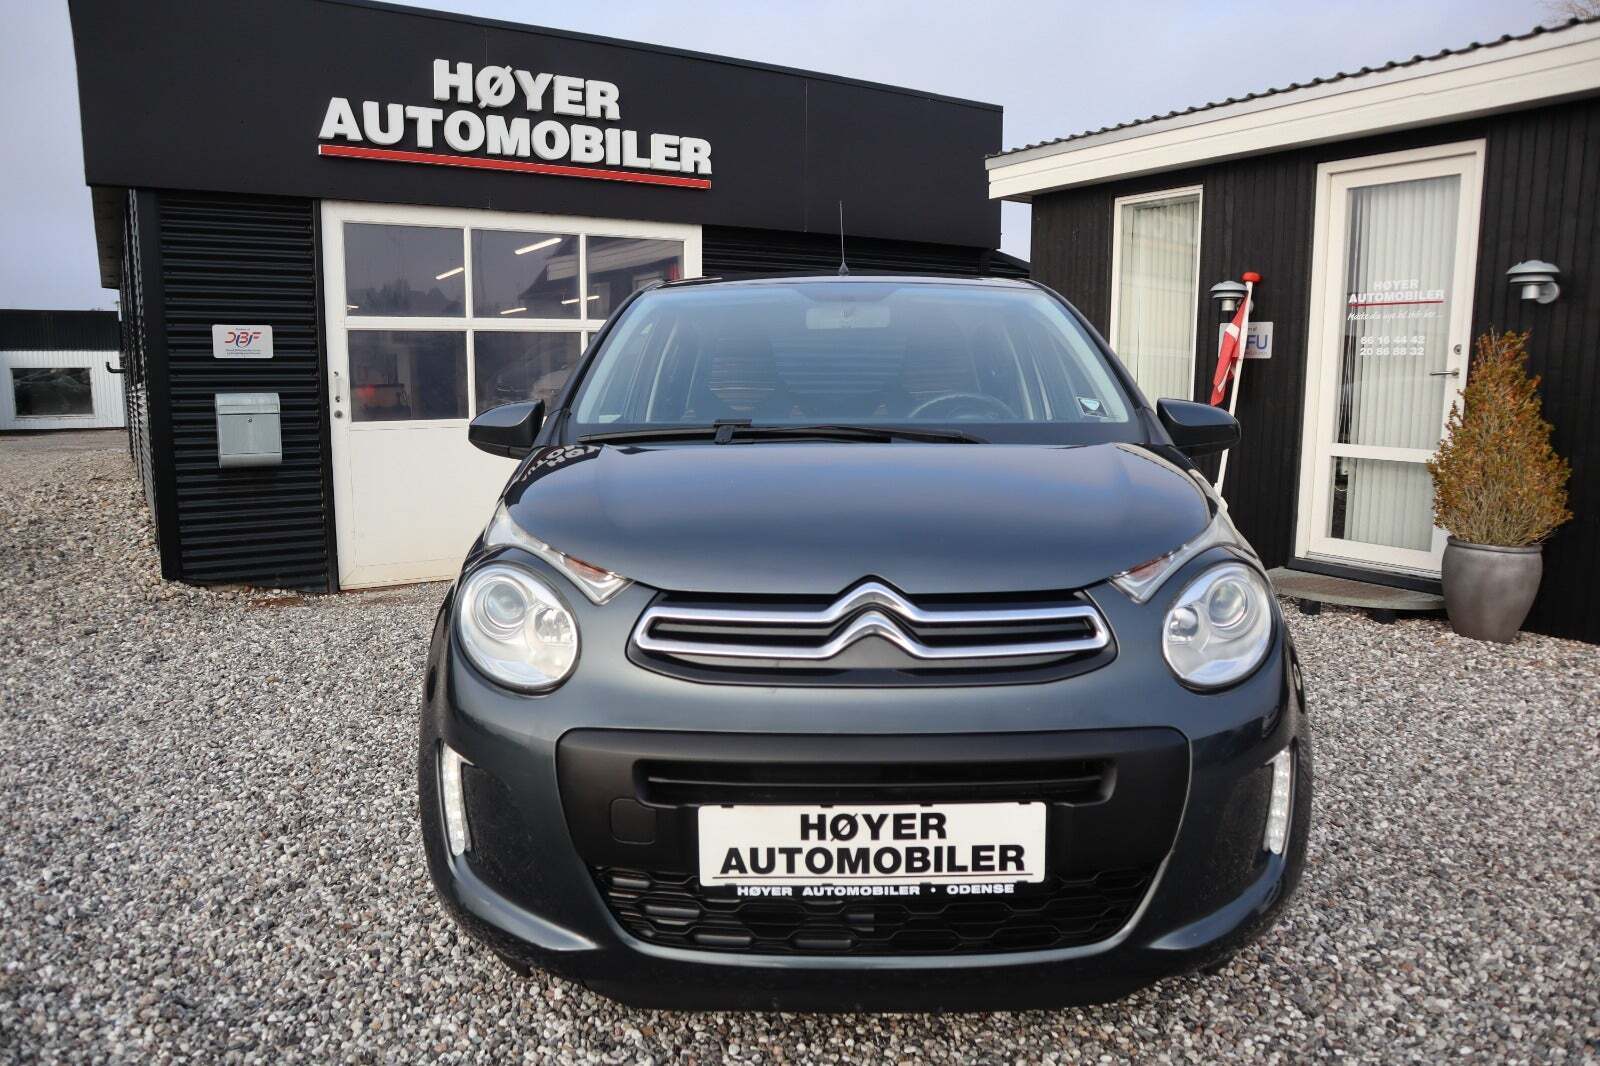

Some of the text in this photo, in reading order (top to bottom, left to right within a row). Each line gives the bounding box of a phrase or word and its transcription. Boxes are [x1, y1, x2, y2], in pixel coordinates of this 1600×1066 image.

[433, 58, 621, 120] HØYER
[318, 97, 712, 175] AUTOMOBILER
[1348, 290, 1444, 304] AUTOMOBILER
[1360, 347, 1374, 356] 20
[1409, 347, 1425, 356] 32
[800, 812, 947, 842] HØYER
[720, 844, 1026, 875] AUTOMOBILER
[737, 884, 1015, 897] HØYER AUTOMOBILER ODENSE
